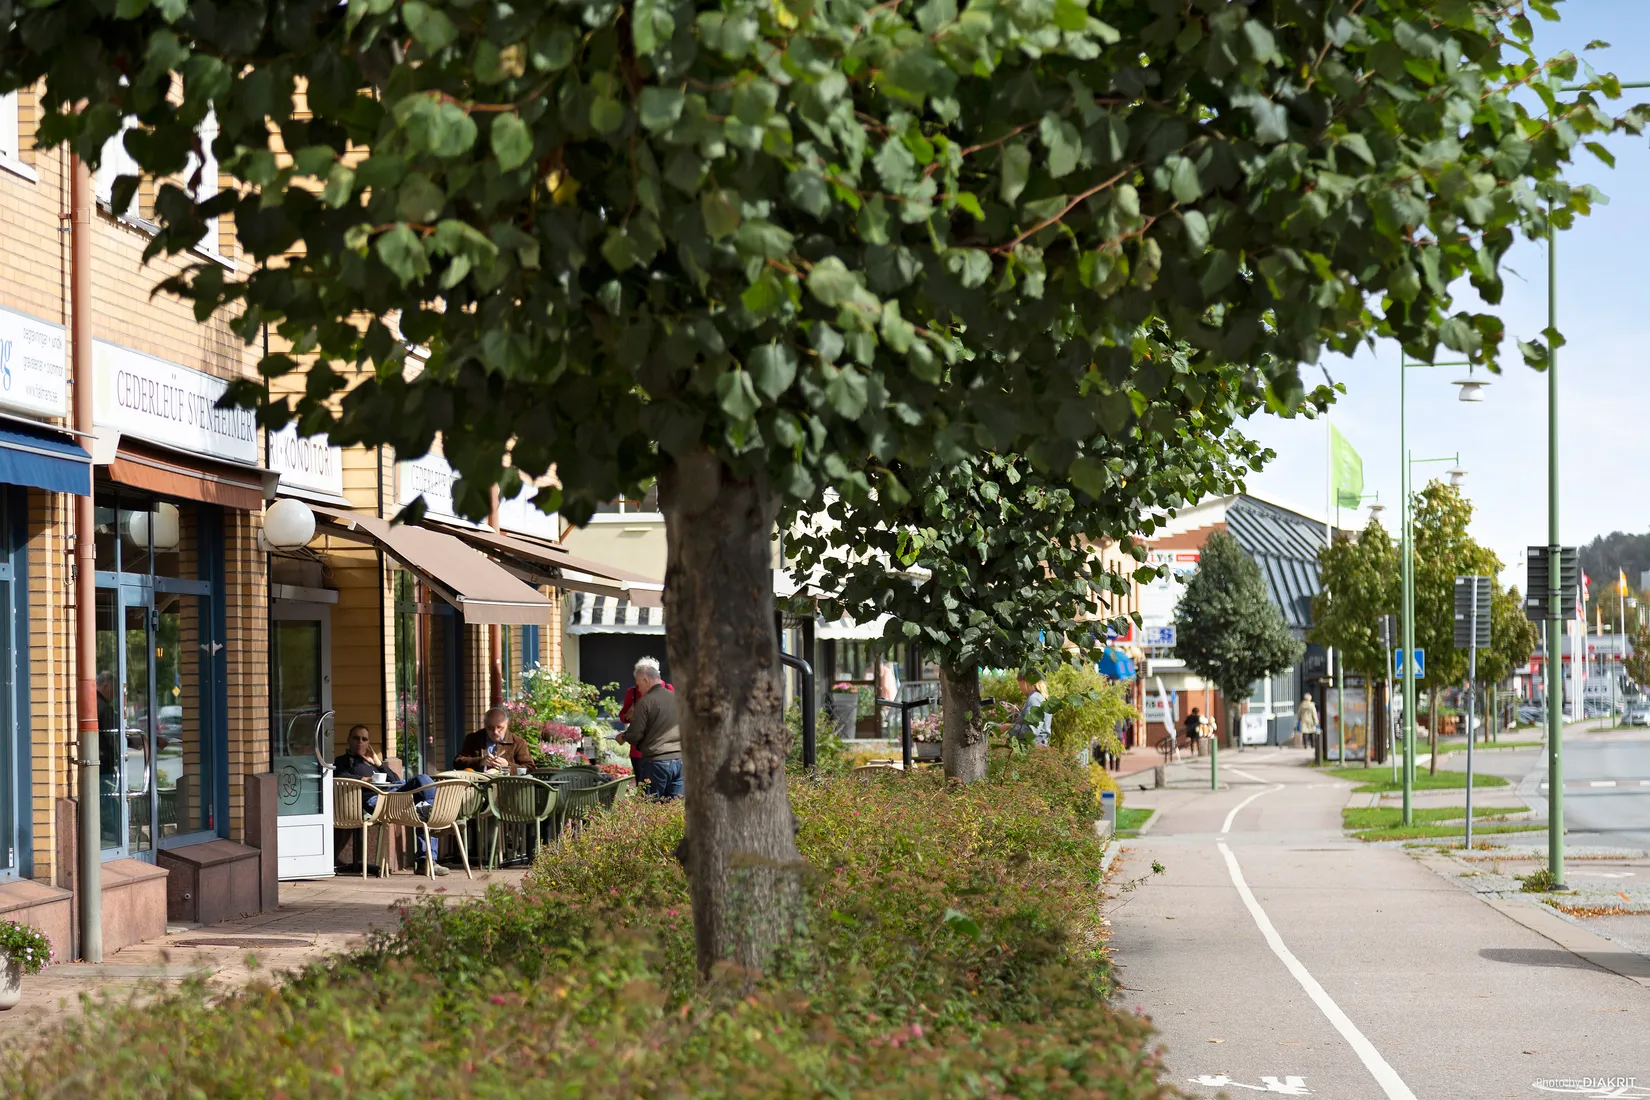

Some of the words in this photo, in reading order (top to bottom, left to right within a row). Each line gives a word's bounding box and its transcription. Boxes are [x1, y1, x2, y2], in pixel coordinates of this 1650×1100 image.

[117, 369, 184, 422] CEDERLEÜF
[188, 391, 254, 443] SVENHEIMER
[285, 435, 333, 477] KONDITORI
